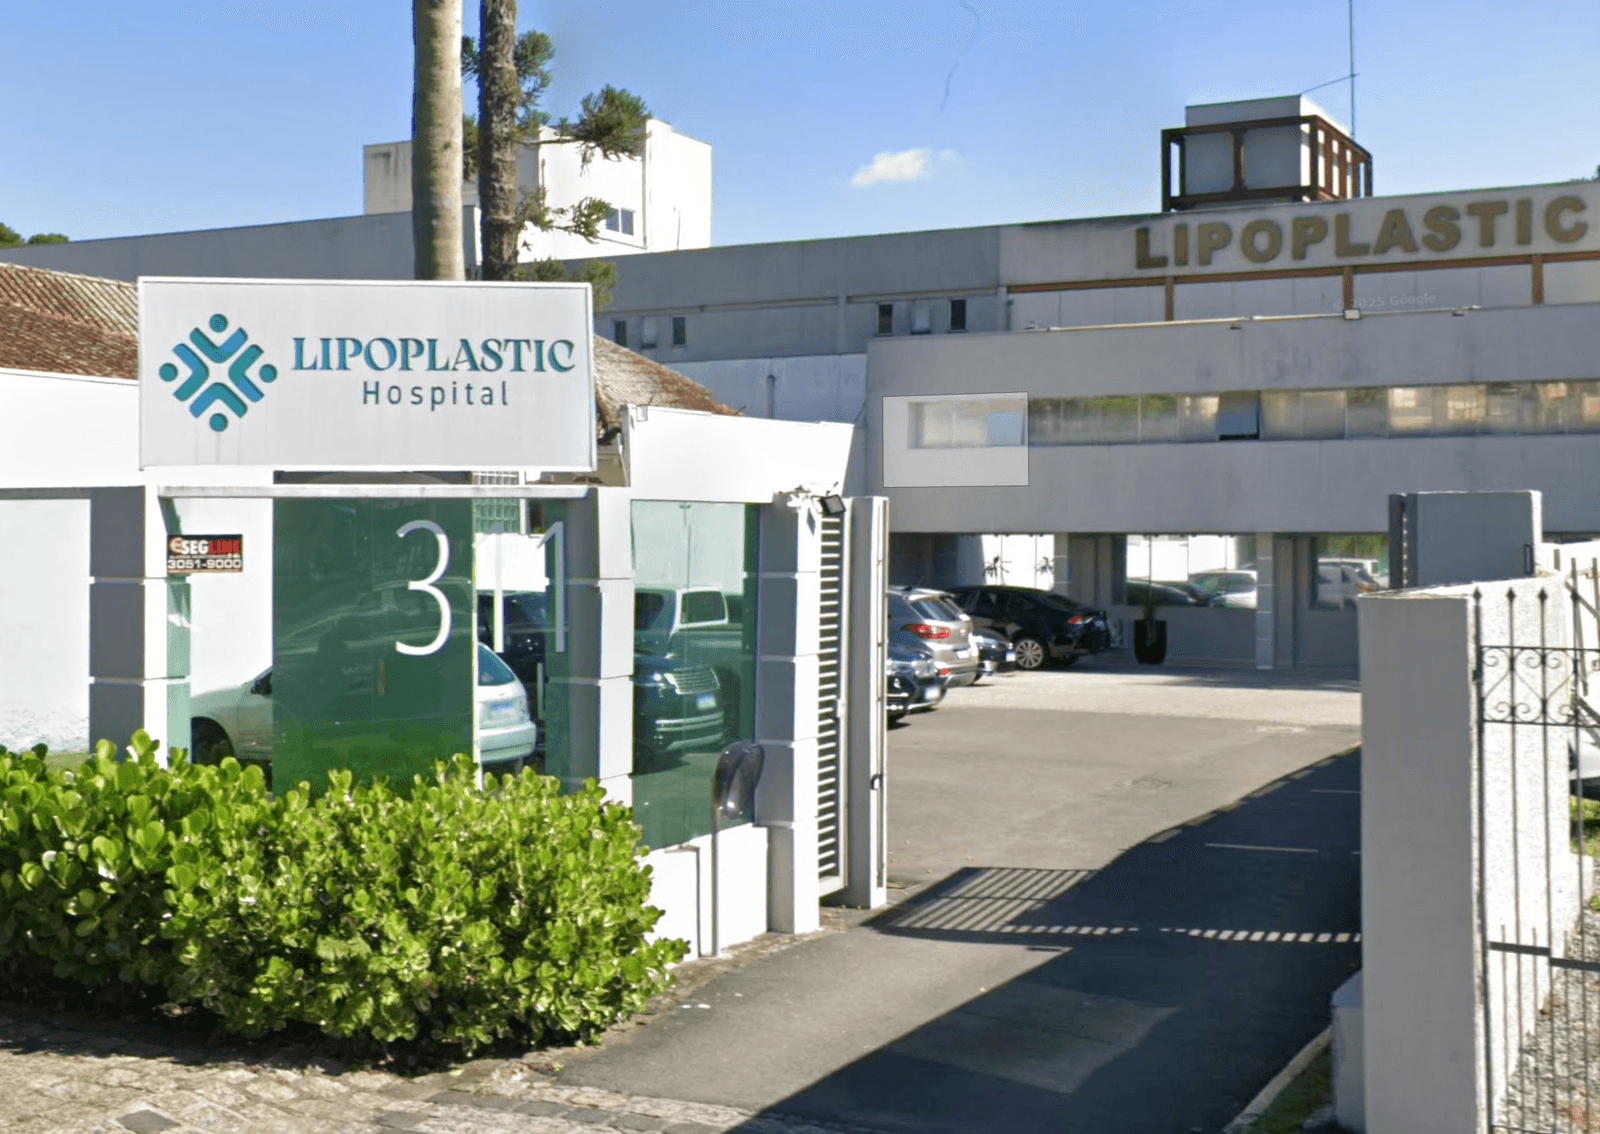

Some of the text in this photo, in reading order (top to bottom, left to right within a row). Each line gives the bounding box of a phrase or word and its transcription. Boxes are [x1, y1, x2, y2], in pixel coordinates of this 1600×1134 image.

[1134, 194, 1589, 269] LIPOPLASTIC
[291, 336, 576, 373] LIPOPLASTIC
[363, 380, 508, 412] Hospital
